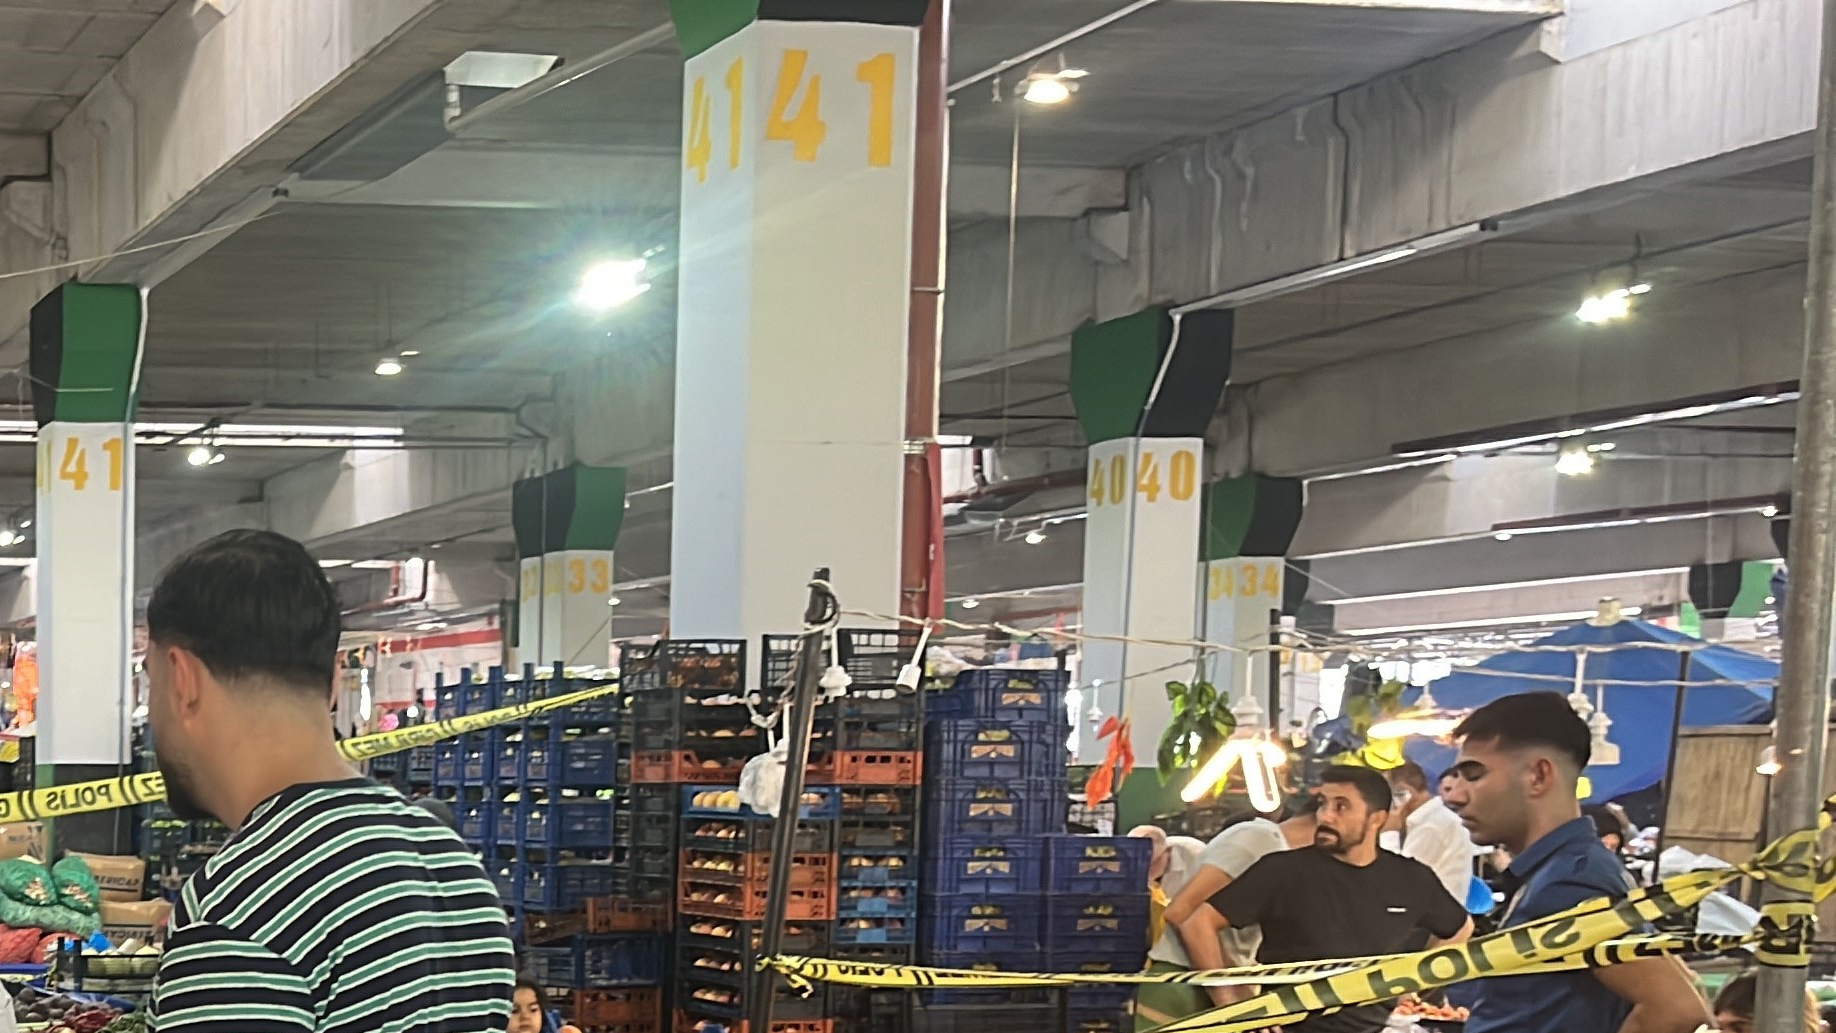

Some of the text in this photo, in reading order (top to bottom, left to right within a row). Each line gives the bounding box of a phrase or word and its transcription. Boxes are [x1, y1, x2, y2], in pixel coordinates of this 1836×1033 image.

[686, 56, 744, 184] 41
[766, 48, 897, 168] 41
[59, 436, 123, 491] 41
[1089, 454, 1127, 507] 40
[1136, 449, 1197, 503] 40
[567, 557, 609, 595] 33
[1240, 564, 1279, 598] 34
